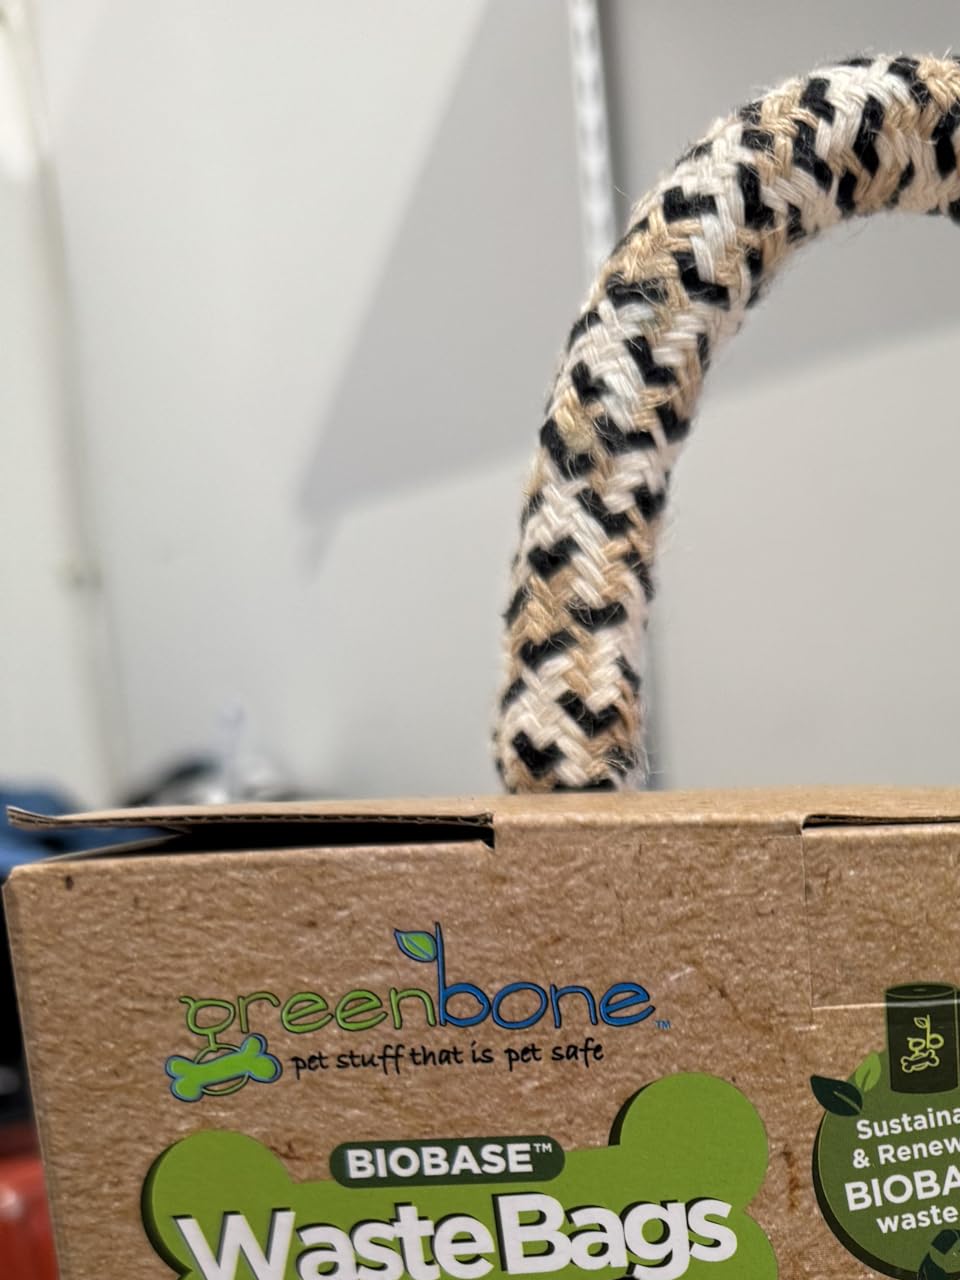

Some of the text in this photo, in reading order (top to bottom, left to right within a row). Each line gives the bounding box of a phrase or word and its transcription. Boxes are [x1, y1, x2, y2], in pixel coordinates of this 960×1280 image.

[291, 1037, 605, 1080] pet stuff that is pet safe
[852, 1149, 870, 1169] &
[876, 1203, 959, 1235] waste
